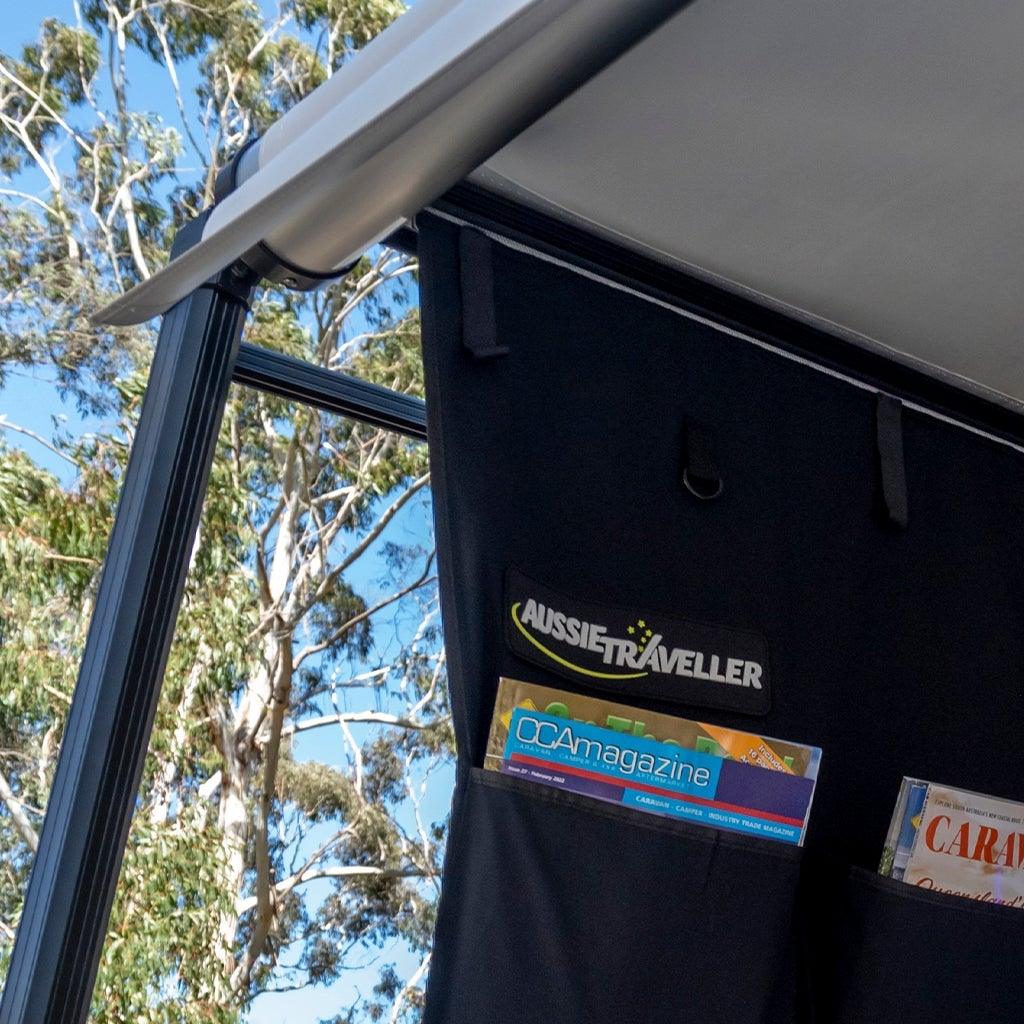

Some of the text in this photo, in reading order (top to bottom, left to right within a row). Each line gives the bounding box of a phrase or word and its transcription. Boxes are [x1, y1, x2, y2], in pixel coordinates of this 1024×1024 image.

[635, 795, 796, 837] CARAVAN CAMPER INDUSTRY TRADE MAGAZINE
